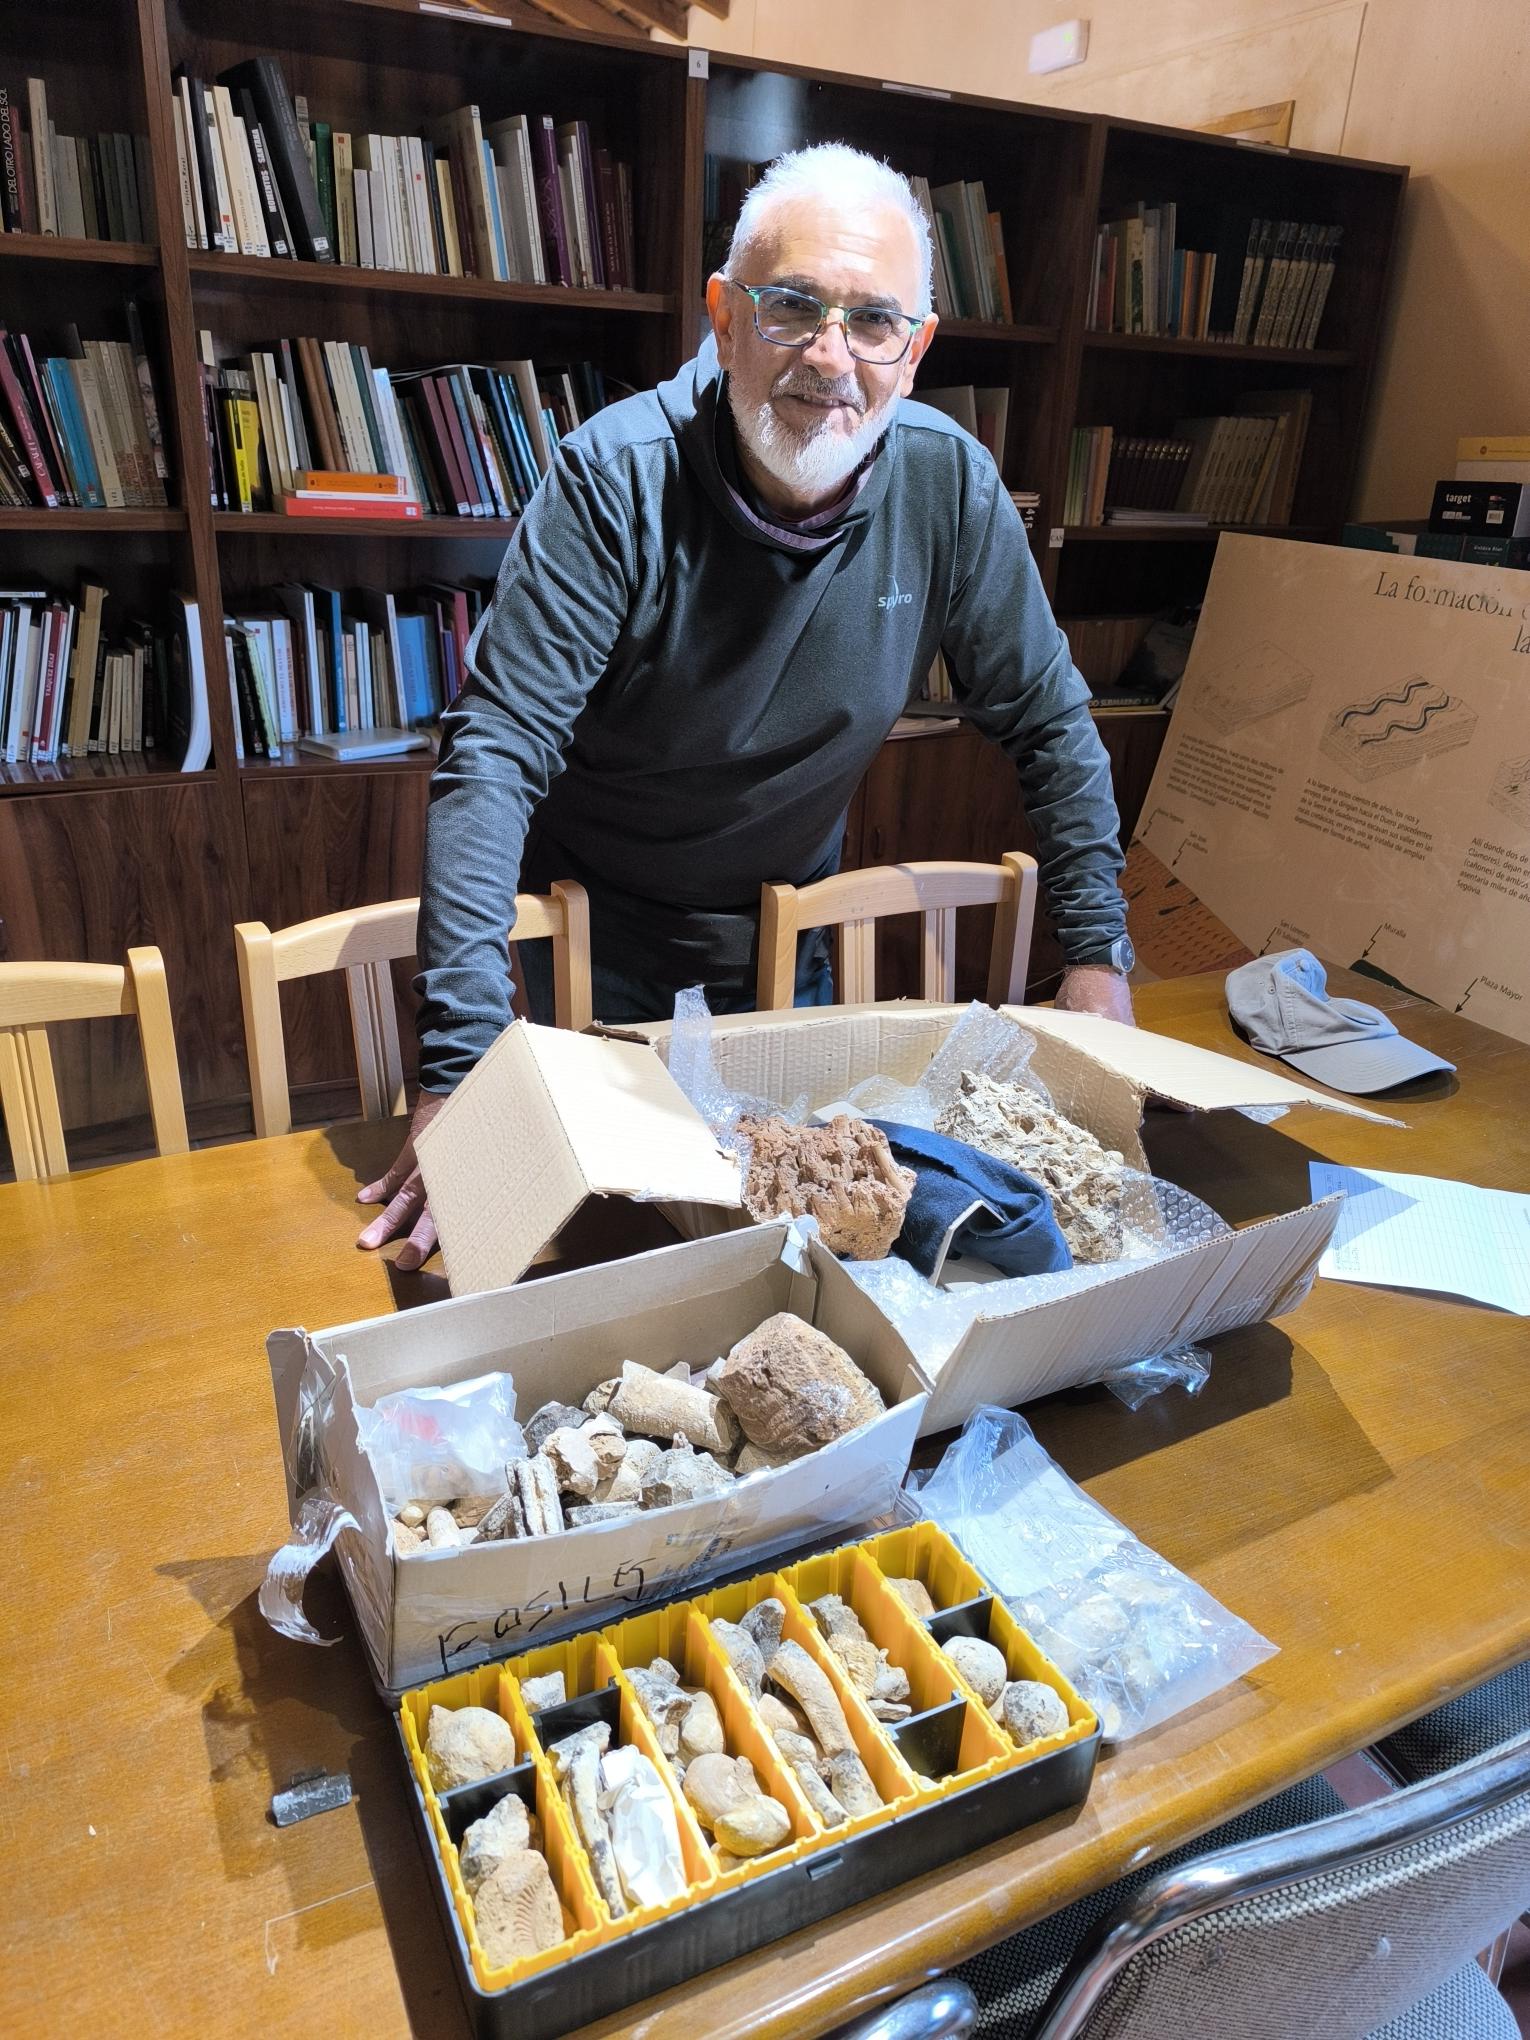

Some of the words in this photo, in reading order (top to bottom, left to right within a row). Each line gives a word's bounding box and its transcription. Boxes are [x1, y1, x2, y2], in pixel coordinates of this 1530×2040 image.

[696, 60, 702, 69] 6
[2, 124, 13, 150] LADO
[251, 129, 266, 164] SANTANA
[5, 152, 15, 177] OTRO
[261, 170, 277, 213] MOMENTOS
[1446, 494, 1472, 504] target
[1374, 571, 1399, 598] La
[878, 592, 913, 612] spyro
[1484, 841, 1505, 855] donde
[1506, 850, 1518, 860] dos
[1520, 855, 1528, 863] de
[1496, 872, 1504, 880] de
[1503, 862, 1522, 873] dejan
[1490, 882, 1507, 893] miles
[1508, 888, 1517, 897] de
[1383, 922, 1406, 939] Muralla
[1480, 976, 1499, 990] Plaza
[1500, 985, 1523, 1000] Mayor
